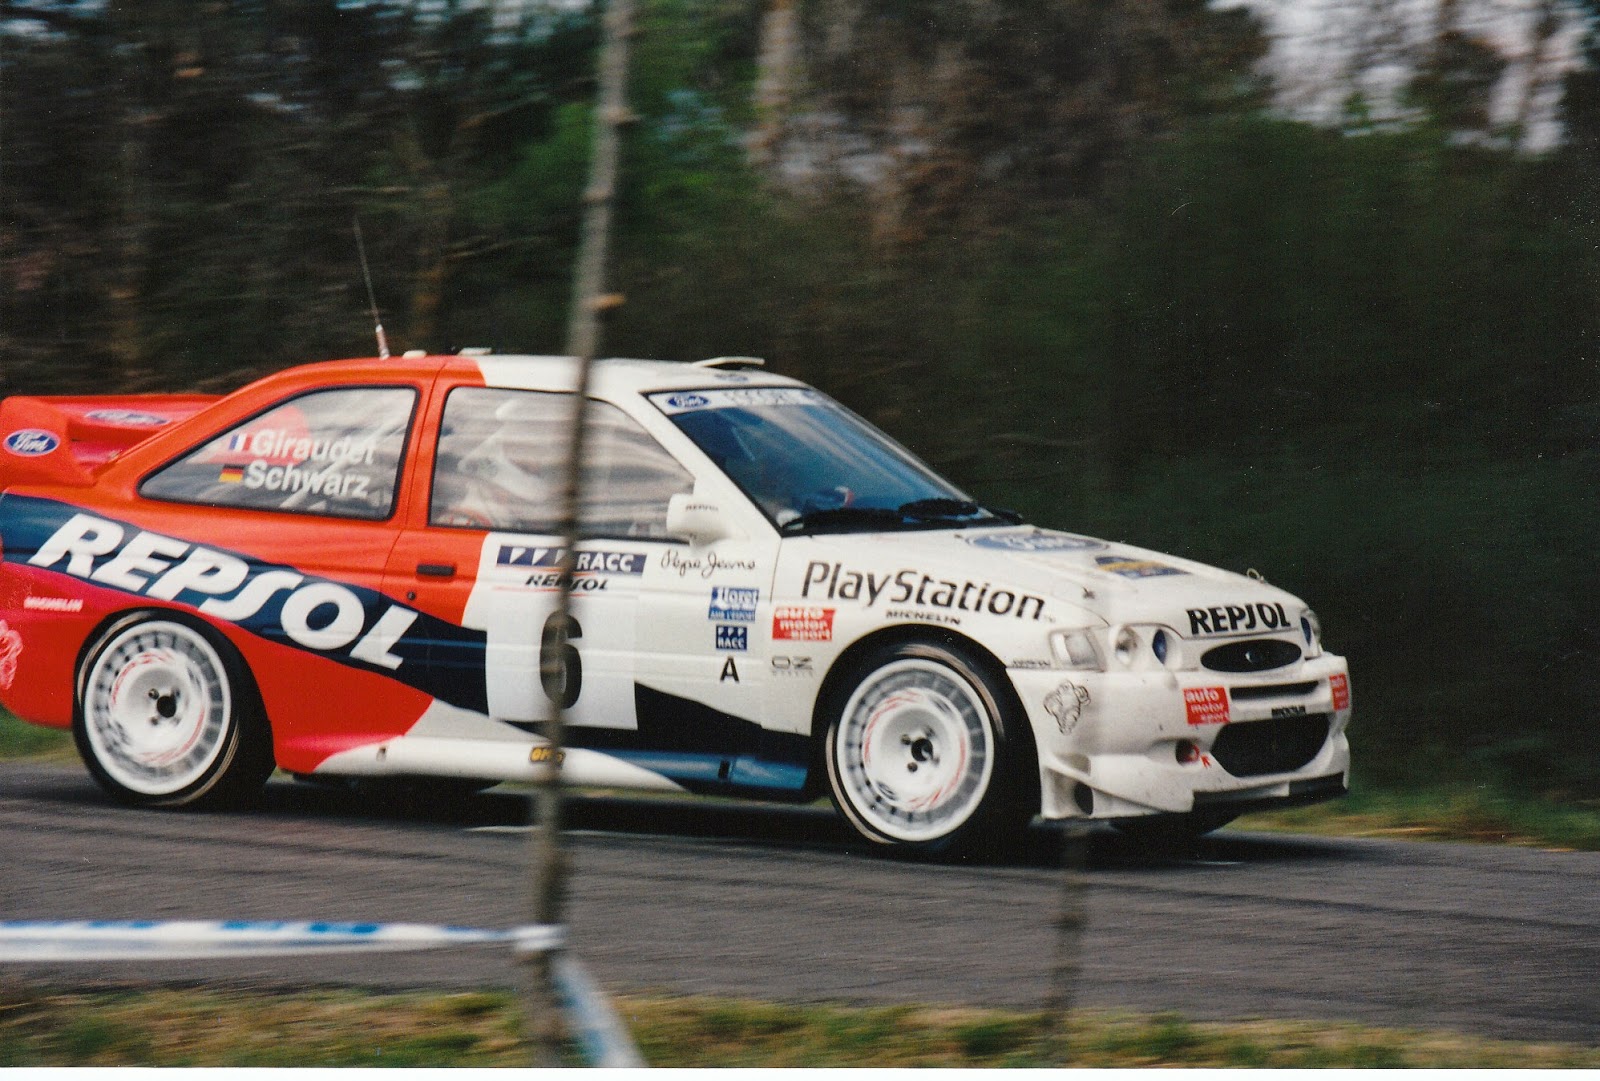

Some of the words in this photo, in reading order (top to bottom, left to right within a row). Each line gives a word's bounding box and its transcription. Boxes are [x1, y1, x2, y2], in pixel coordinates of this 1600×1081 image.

[251, 429, 376, 465] Giraudet
[244, 459, 371, 499] Schwarz
[576, 552, 635, 572] RACC
[701, 550, 756, 579] Jeans
[28, 512, 419, 670] REPSOL
[802, 561, 1046, 621] PlayStation
[775, 607, 824, 620] auto
[780, 619, 829, 631] motor
[1185, 602, 1292, 636] REPSOL
[717, 636, 746, 650] RACC
[540, 609, 583, 710] 6
[720, 655, 740, 682] A
[1184, 688, 1220, 703] auto
[1190, 702, 1225, 714] motor
